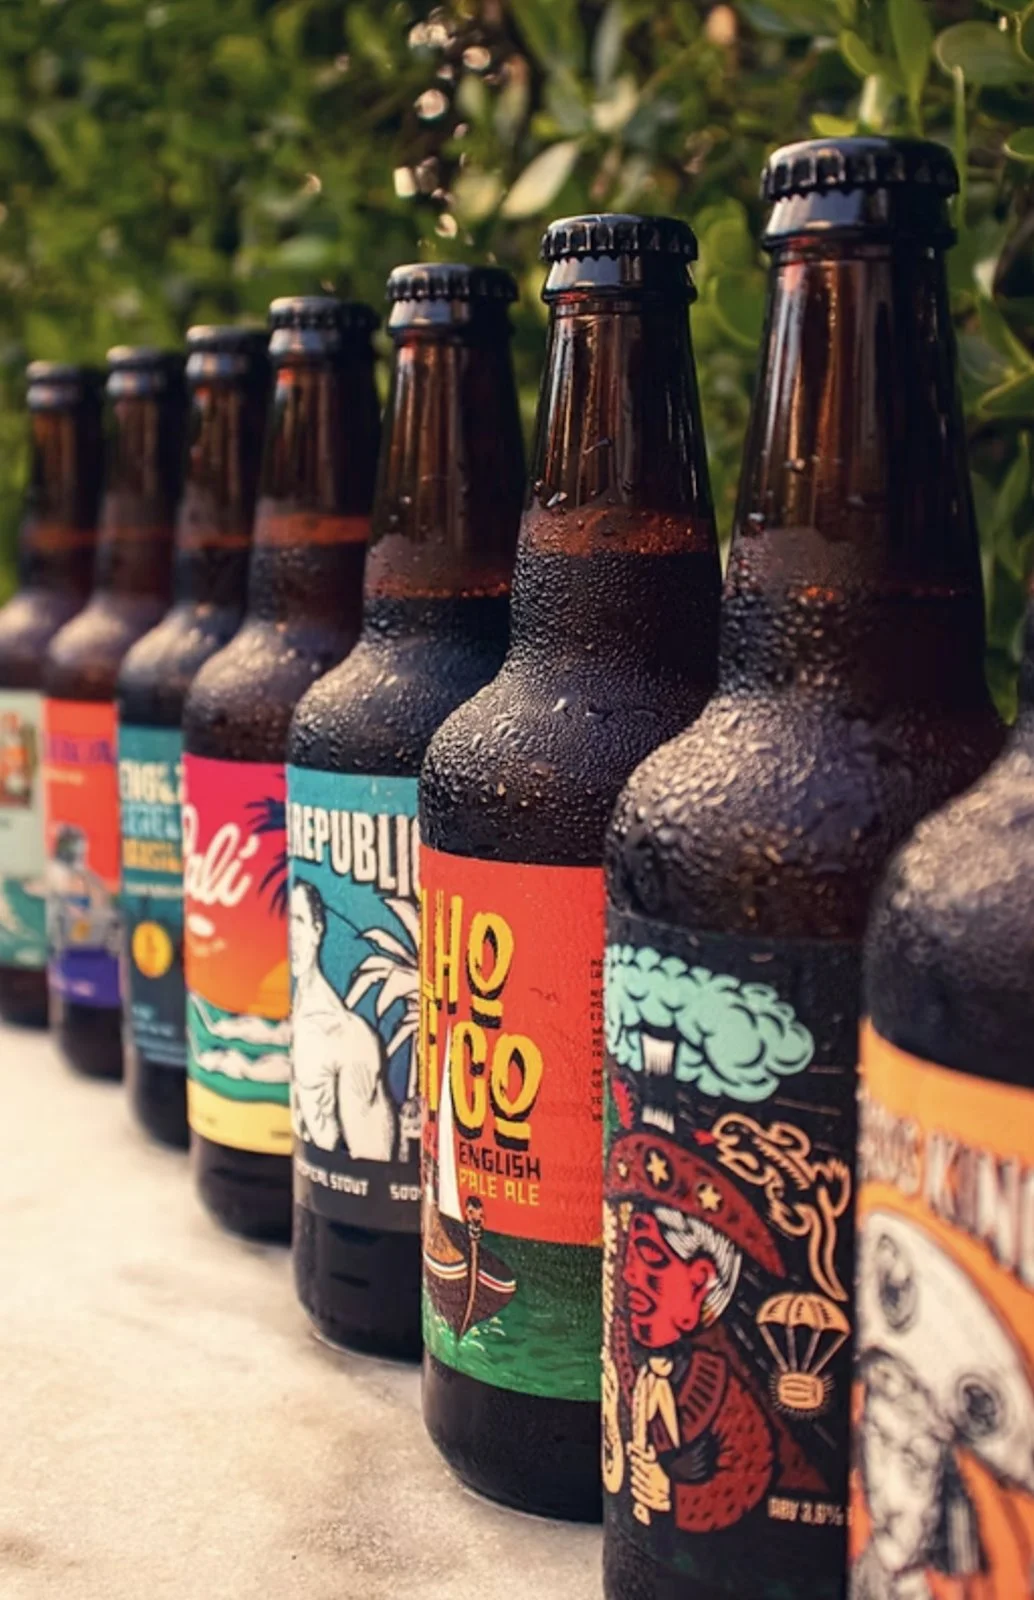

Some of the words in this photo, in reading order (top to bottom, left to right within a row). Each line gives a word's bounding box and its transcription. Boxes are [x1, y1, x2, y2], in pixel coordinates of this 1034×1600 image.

[458, 1140, 541, 1181] ENGLISH
[329, 1171, 370, 1198] STOUT
[458, 1166, 498, 1199] PALE
[503, 1180, 541, 1206] ALE
